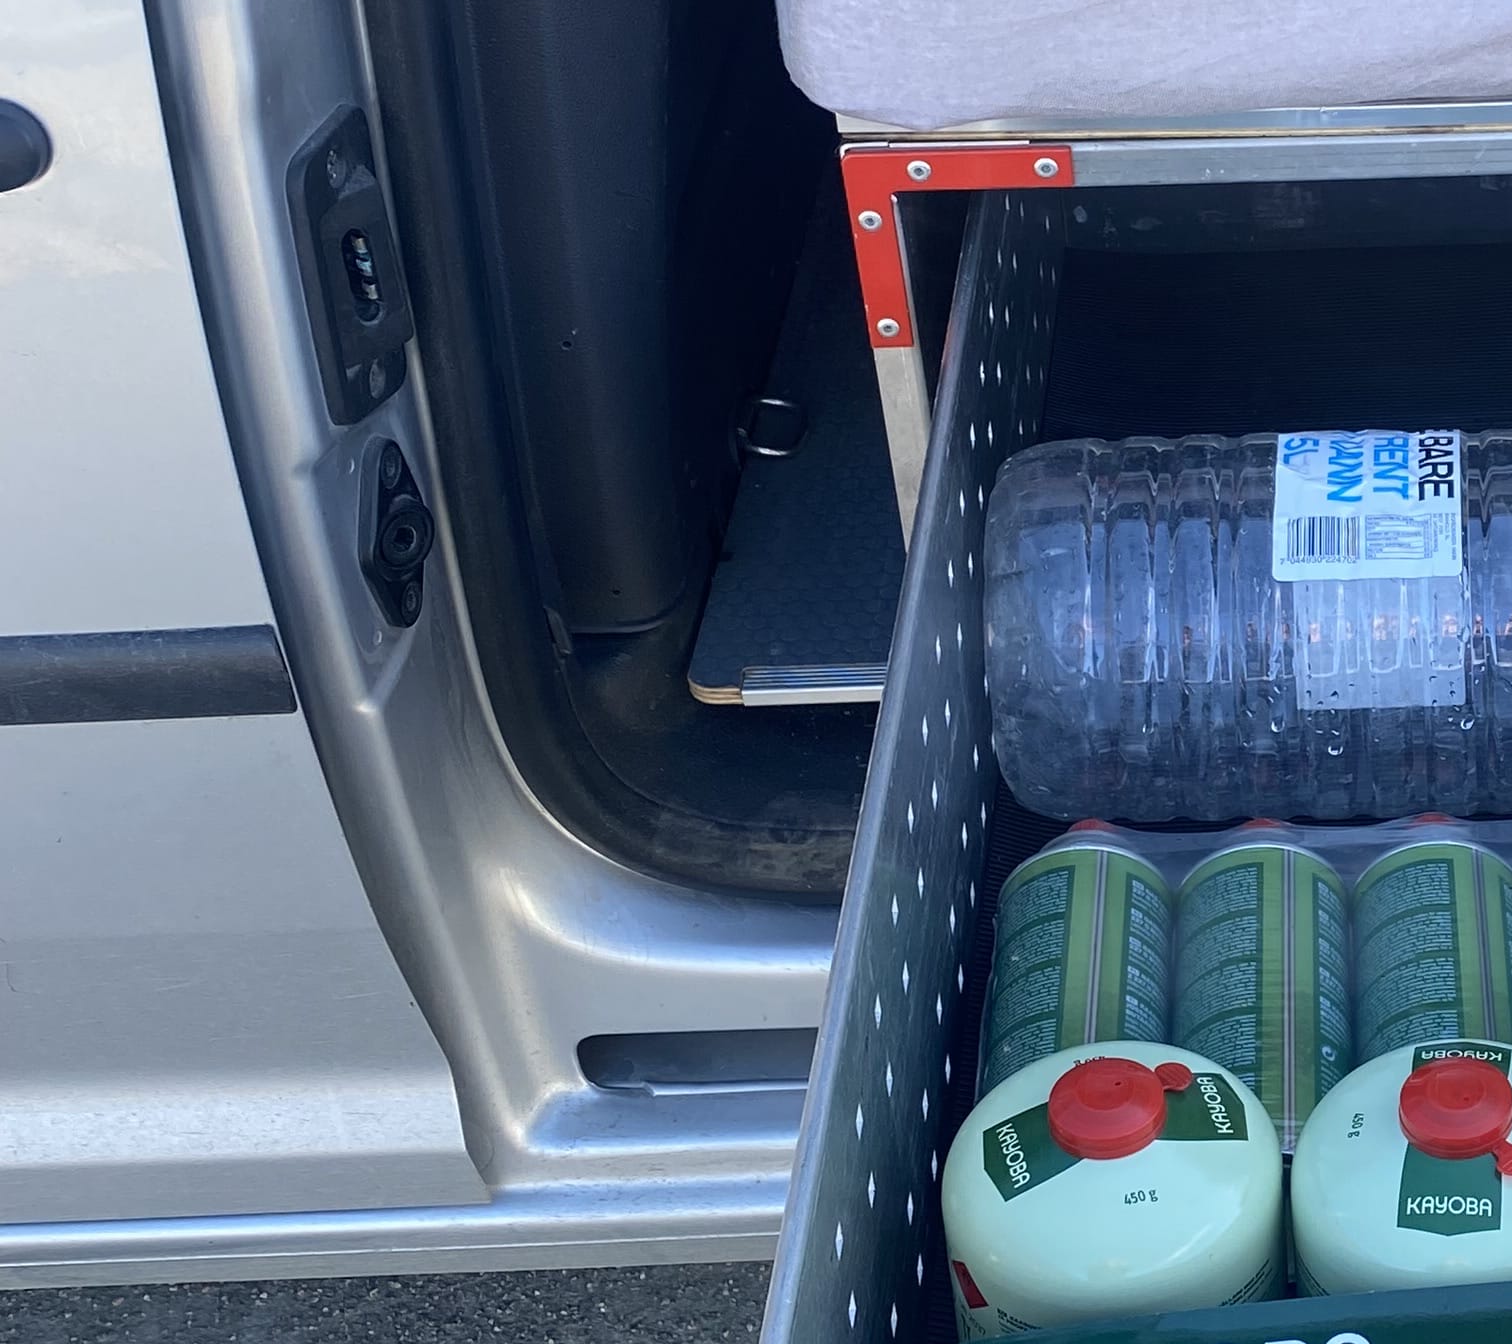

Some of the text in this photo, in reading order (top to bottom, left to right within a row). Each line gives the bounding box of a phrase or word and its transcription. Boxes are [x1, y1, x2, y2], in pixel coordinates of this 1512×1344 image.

[1283, 437, 1319, 465] 5L
[1327, 438, 1364, 502] VANN
[1373, 437, 1409, 500] RENT
[1418, 436, 1455, 501] BARE
[1421, 1049, 1503, 1062] KAYOBA
[1196, 1076, 1234, 1134] KAYOBA
[1350, 1113, 1365, 1131] 450
[996, 1123, 1030, 1189] KAYOBA
[1123, 1188, 1158, 1205] 450 g
[1406, 1196, 1492, 1216] KAYOBA
